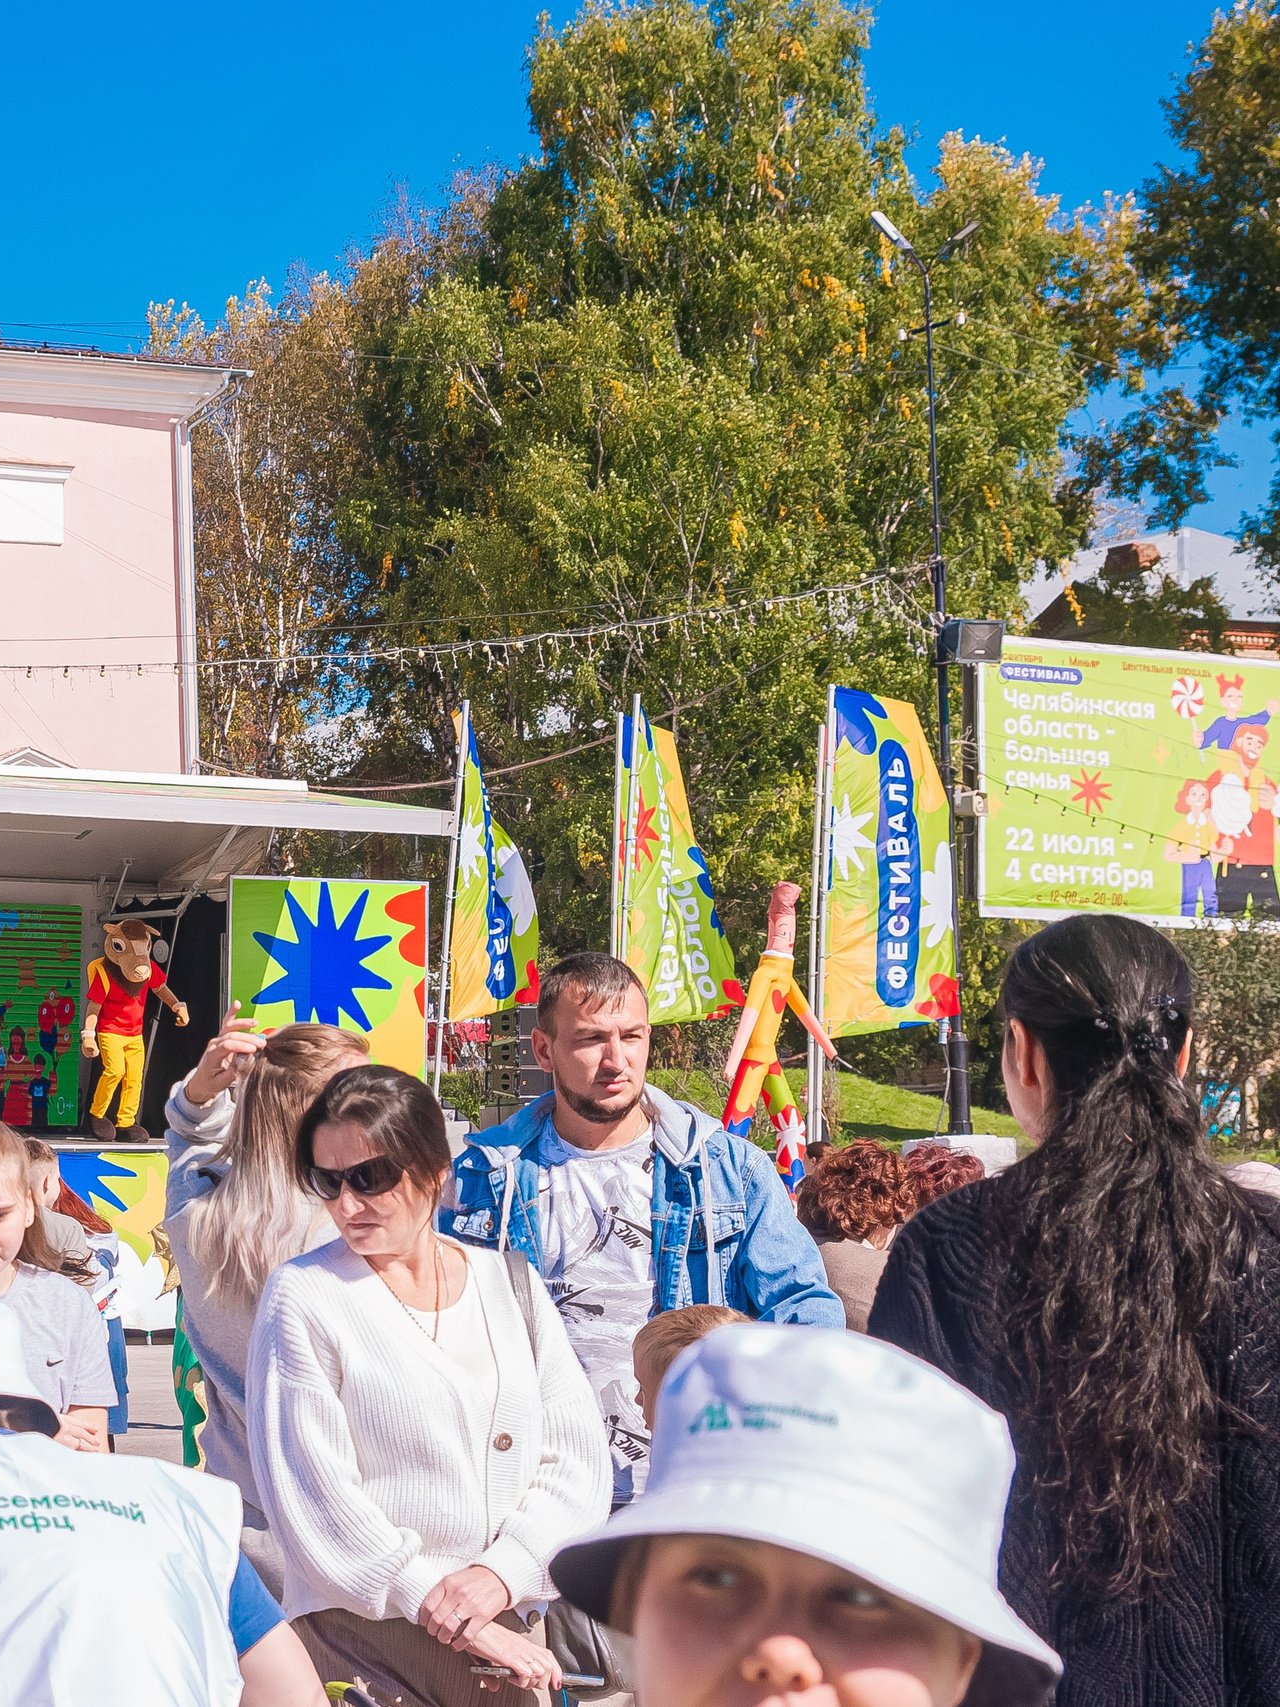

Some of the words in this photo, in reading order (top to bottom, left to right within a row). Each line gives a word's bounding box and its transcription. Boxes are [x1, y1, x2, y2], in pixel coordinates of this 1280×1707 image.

[1005, 666, 1078, 682] ФЕСТИВАЛЬ
[1003, 687, 1155, 720] Челябинская
[1004, 714, 1100, 741] область
[1004, 739, 1110, 767] большая
[1004, 769, 1071, 791] семья
[1005, 826, 1035, 852] 22
[1042, 833, 1115, 856] июля
[887, 757, 911, 990] ФЕСТИВАЛЬ
[1005, 857, 1021, 882] 4
[1030, 862, 1153, 893] сентября
[613, 1224, 644, 1250] NIKE
[613, 1435, 647, 1462] NIKE
